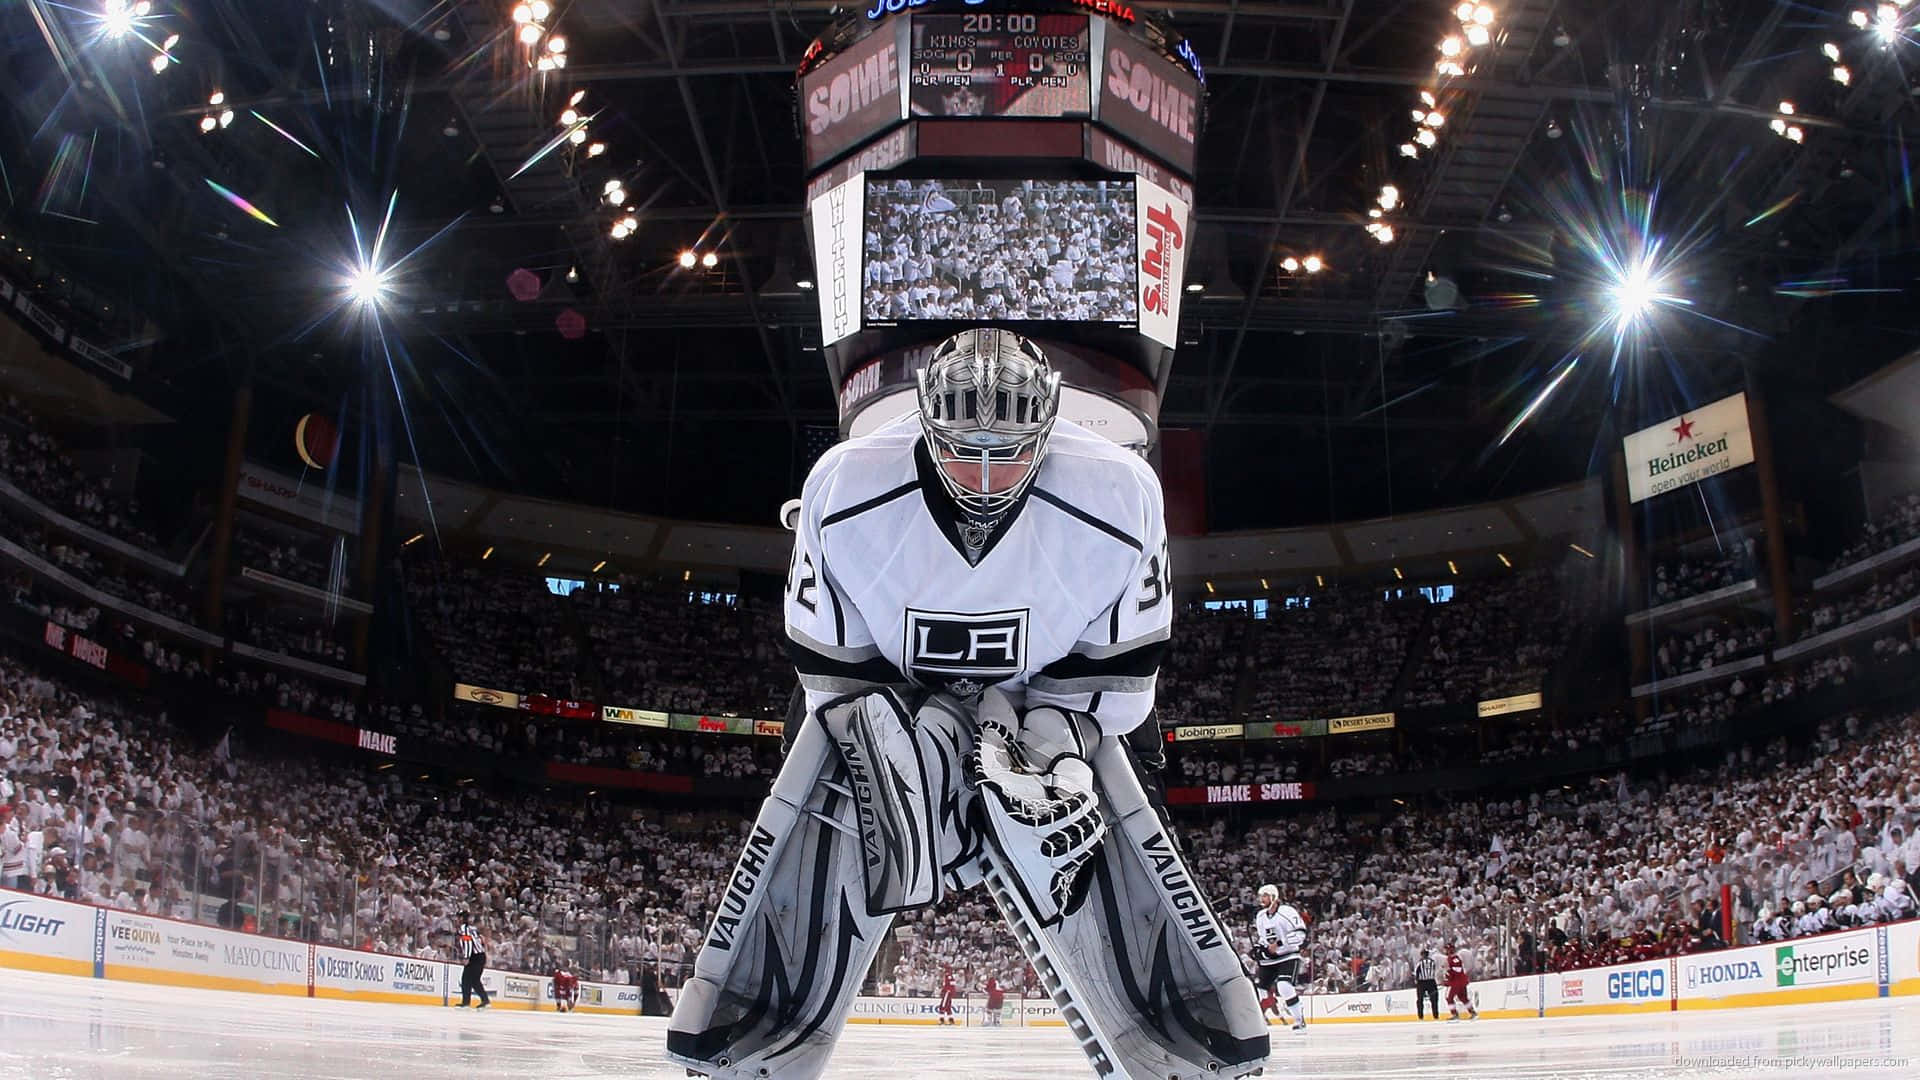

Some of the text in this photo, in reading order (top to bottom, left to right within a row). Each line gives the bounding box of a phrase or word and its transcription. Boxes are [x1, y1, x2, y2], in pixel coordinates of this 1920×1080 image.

[963, 15, 1036, 33] 20:00
[930, 36, 976, 48] KINGS
[1014, 36, 1078, 49] COYOTES
[913, 51, 945, 60] SOG
[957, 52, 973, 72] 0
[1029, 53, 1044, 72] 0
[1054, 52, 1086, 62] SOG
[809, 43, 898, 136] SOME
[946, 76, 970, 86] PEN
[1042, 76, 1066, 86] PEN
[1108, 49, 1195, 144] SOME
[829, 184, 848, 338] WHITEOUT
[1141, 202, 1183, 315] fry's
[1648, 438, 1728, 477] Heineken
[916, 625, 1017, 662] LA
[606, 708, 634, 720] WM
[359, 728, 397, 755] MAKE
[840, 742, 881, 868] VAUGHN
[1207, 783, 1303, 803] MAKE SOME
[708, 824, 776, 952] VAUGHN
[1141, 831, 1223, 951] VAUGHN
[1, 909, 65, 937] LIGHT
[224, 944, 261, 968] MAYO
[262, 950, 302, 973] CLINIC
[327, 957, 354, 978] DESERT
[355, 960, 384, 982] SCHOOLS
[1780, 945, 1870, 976] enterprise
[405, 963, 434, 982] ARIZONA
[1608, 969, 1665, 998] GEICO
[1700, 961, 1763, 984] HONDA
[854, 1002, 901, 1014] CLINIC
